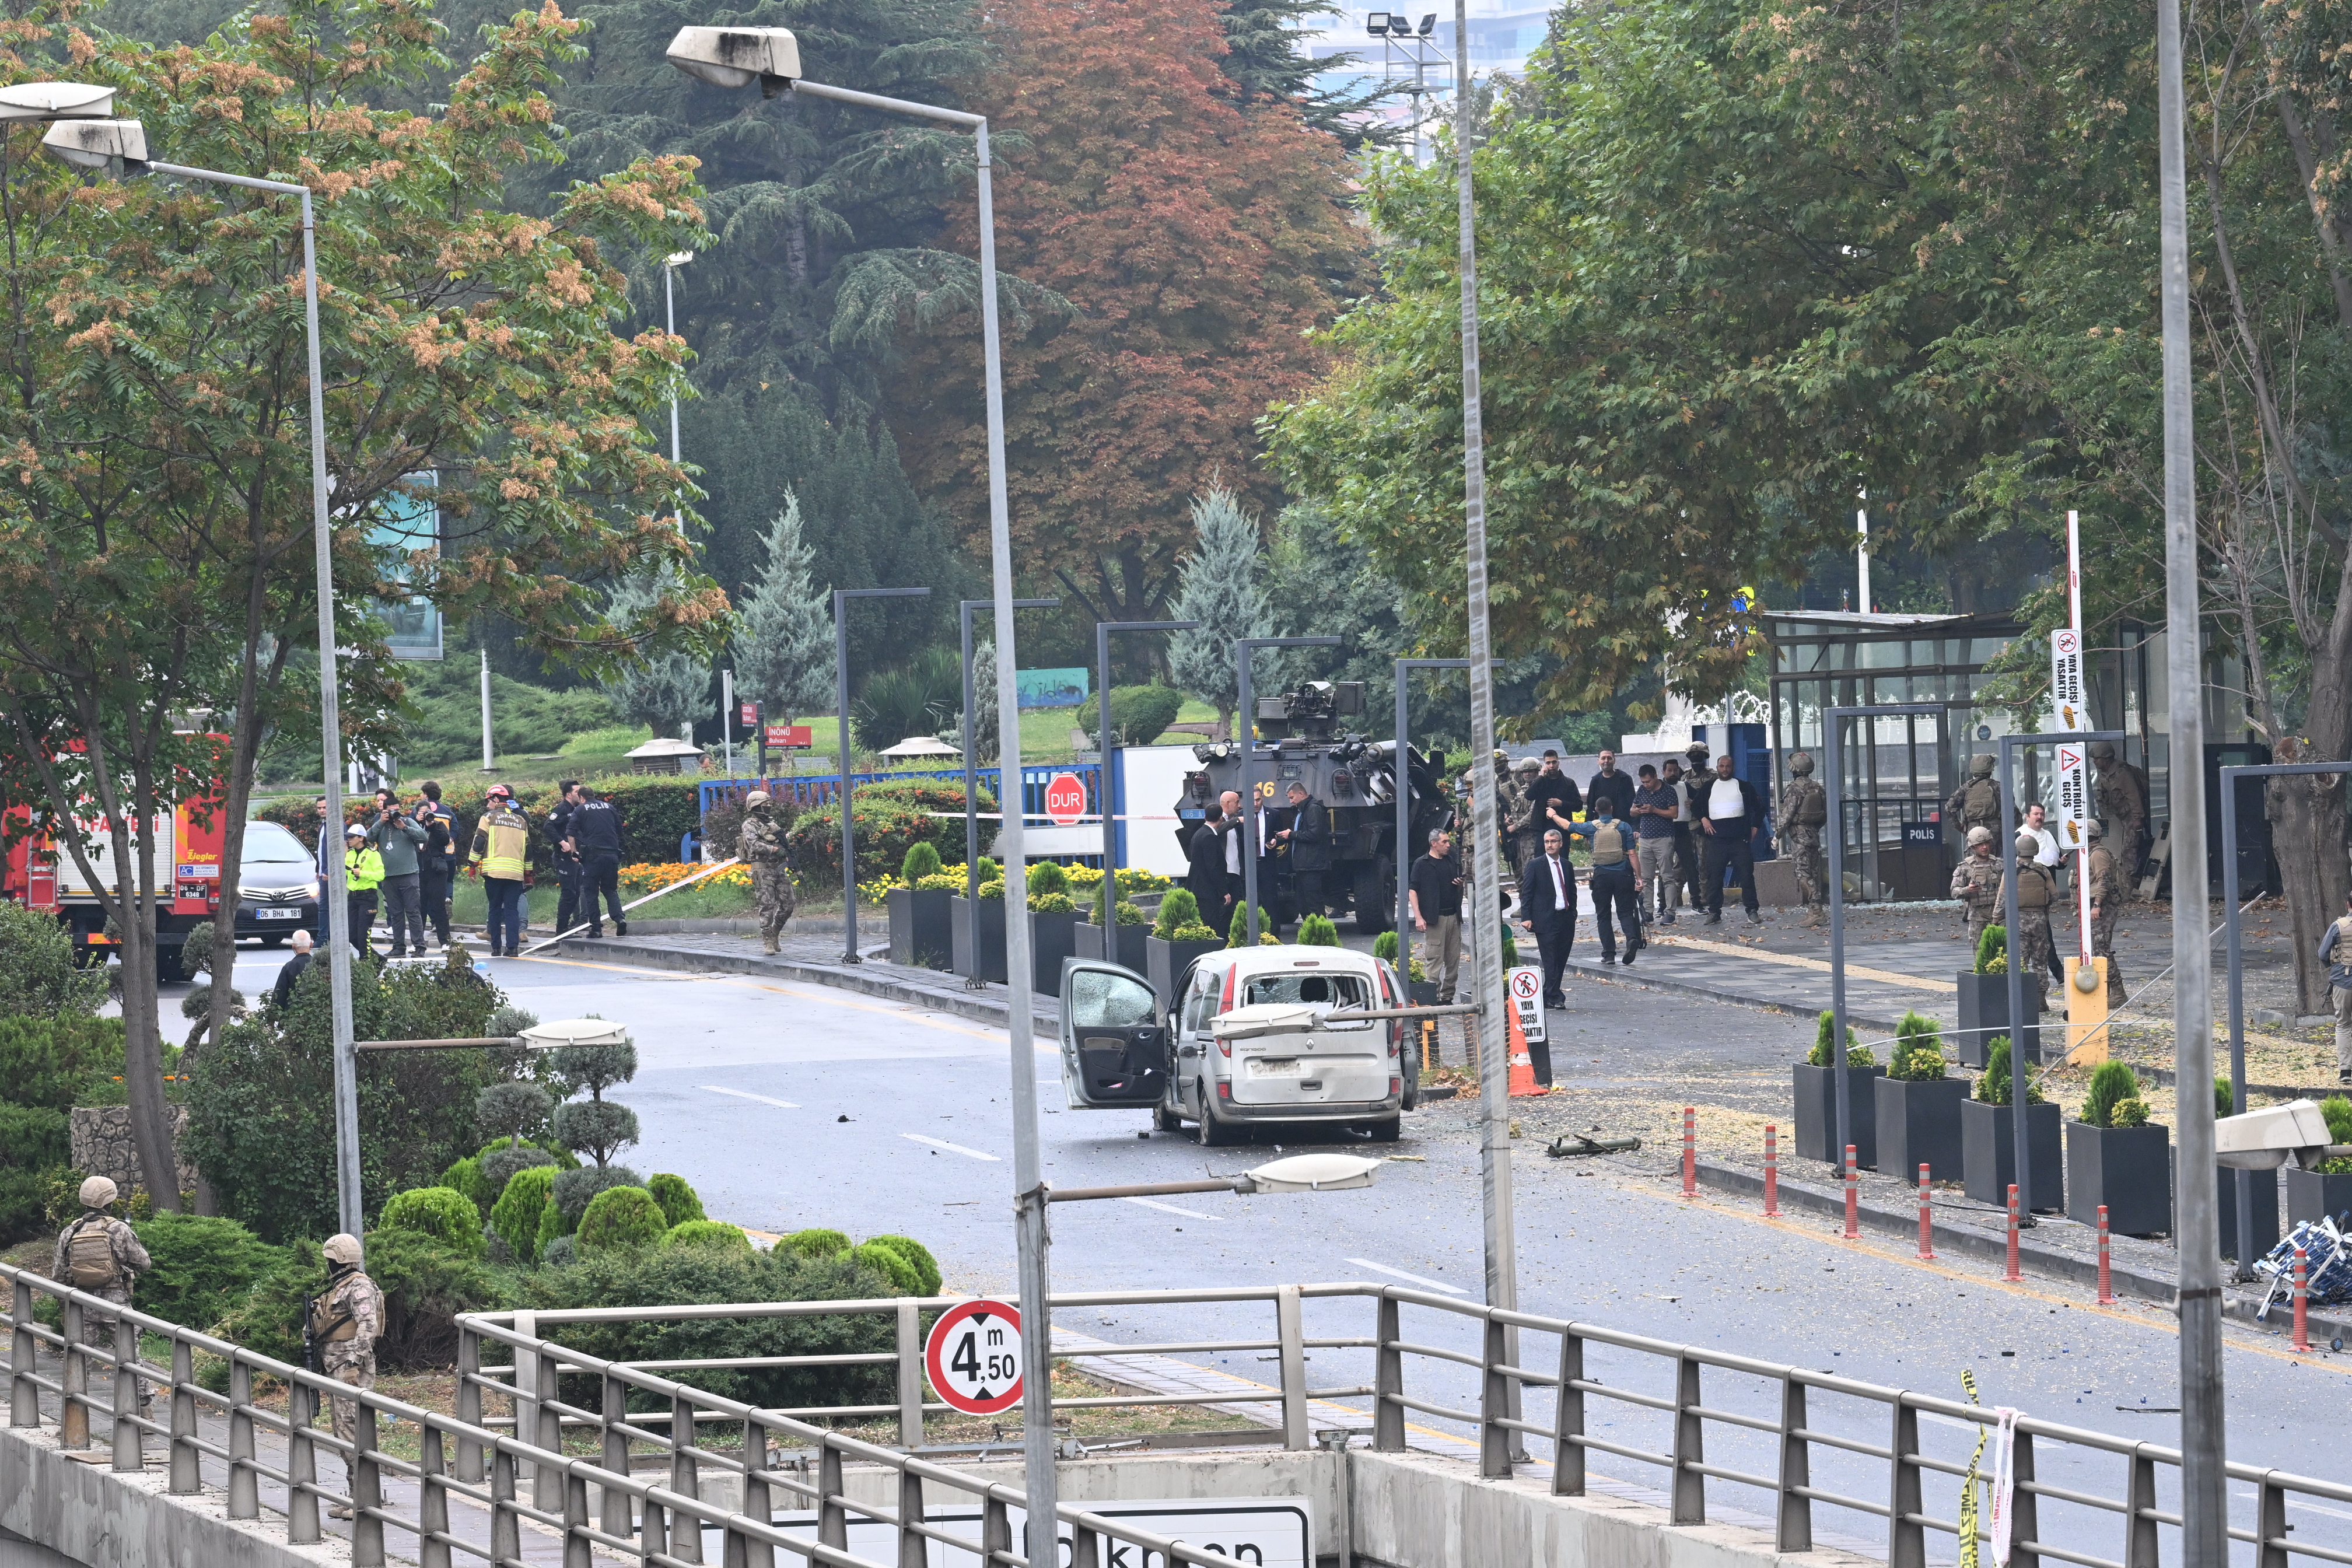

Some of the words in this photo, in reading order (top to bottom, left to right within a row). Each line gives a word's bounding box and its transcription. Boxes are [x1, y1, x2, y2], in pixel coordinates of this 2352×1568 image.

[2068, 653, 2077, 673] YAYA
[2057, 658, 2067, 699] YASAKTIR
[2067, 675, 2080, 704] GEÇİŞİ
[769, 726, 790, 736] İNÖNÜ
[1051, 792, 1080, 807] DUR
[2061, 781, 2073, 808] GEÇİŞ
[2072, 769, 2084, 820] KONTROLLÜ
[73, 816, 159, 832] İTFAEİ
[496, 813, 519, 823] ANKARA
[1910, 827, 1935, 839] POLİS
[187, 849, 218, 863] Ziegler
[1520, 1000, 1534, 1011] YAYA
[1522, 1027, 1542, 1038] SAKTIR
[988, 1328, 1003, 1346] m
